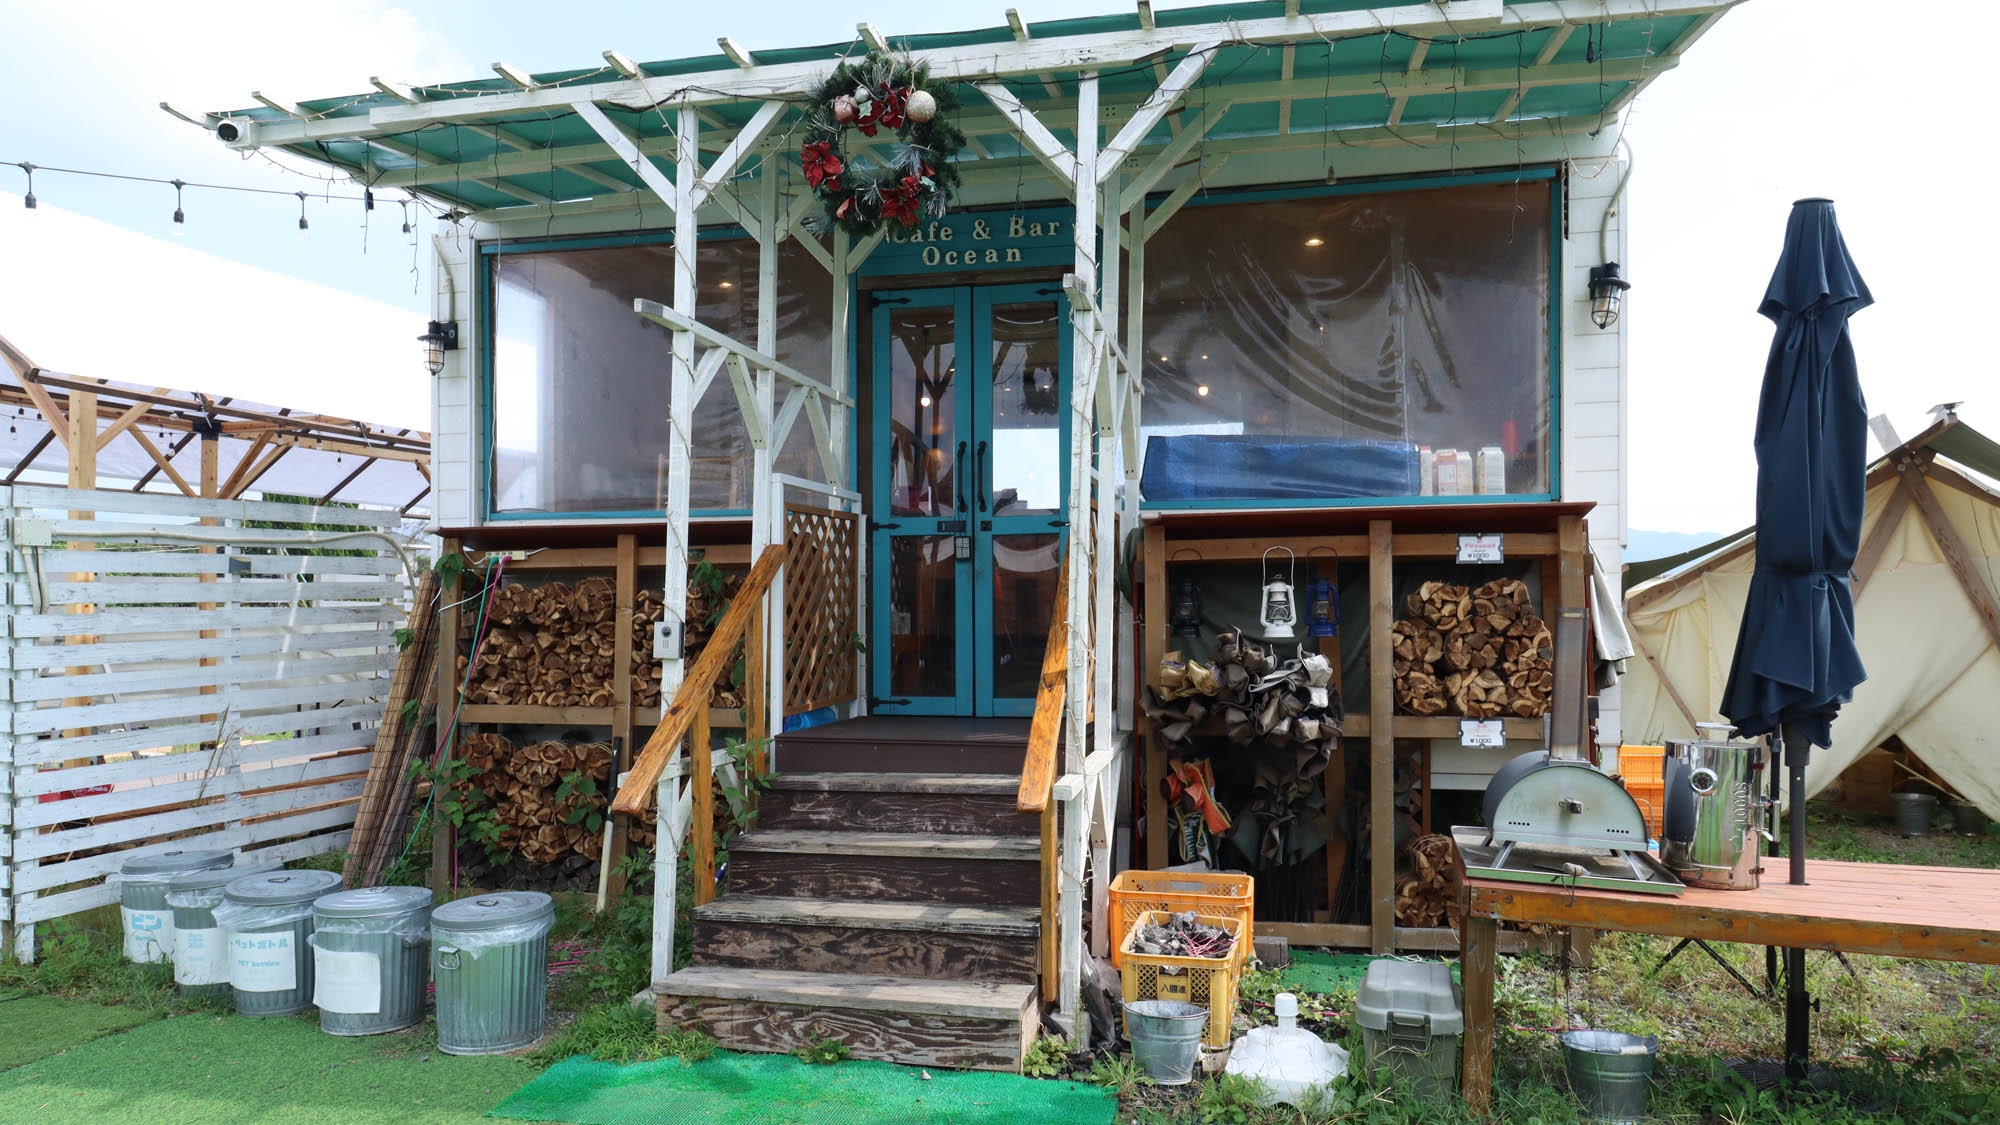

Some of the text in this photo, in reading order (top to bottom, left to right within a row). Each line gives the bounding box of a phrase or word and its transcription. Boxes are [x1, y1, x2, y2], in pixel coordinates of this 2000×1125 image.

[973, 219, 992, 240] &
[1009, 216, 1061, 238] Bar
[922, 246, 1023, 266] Ocean
